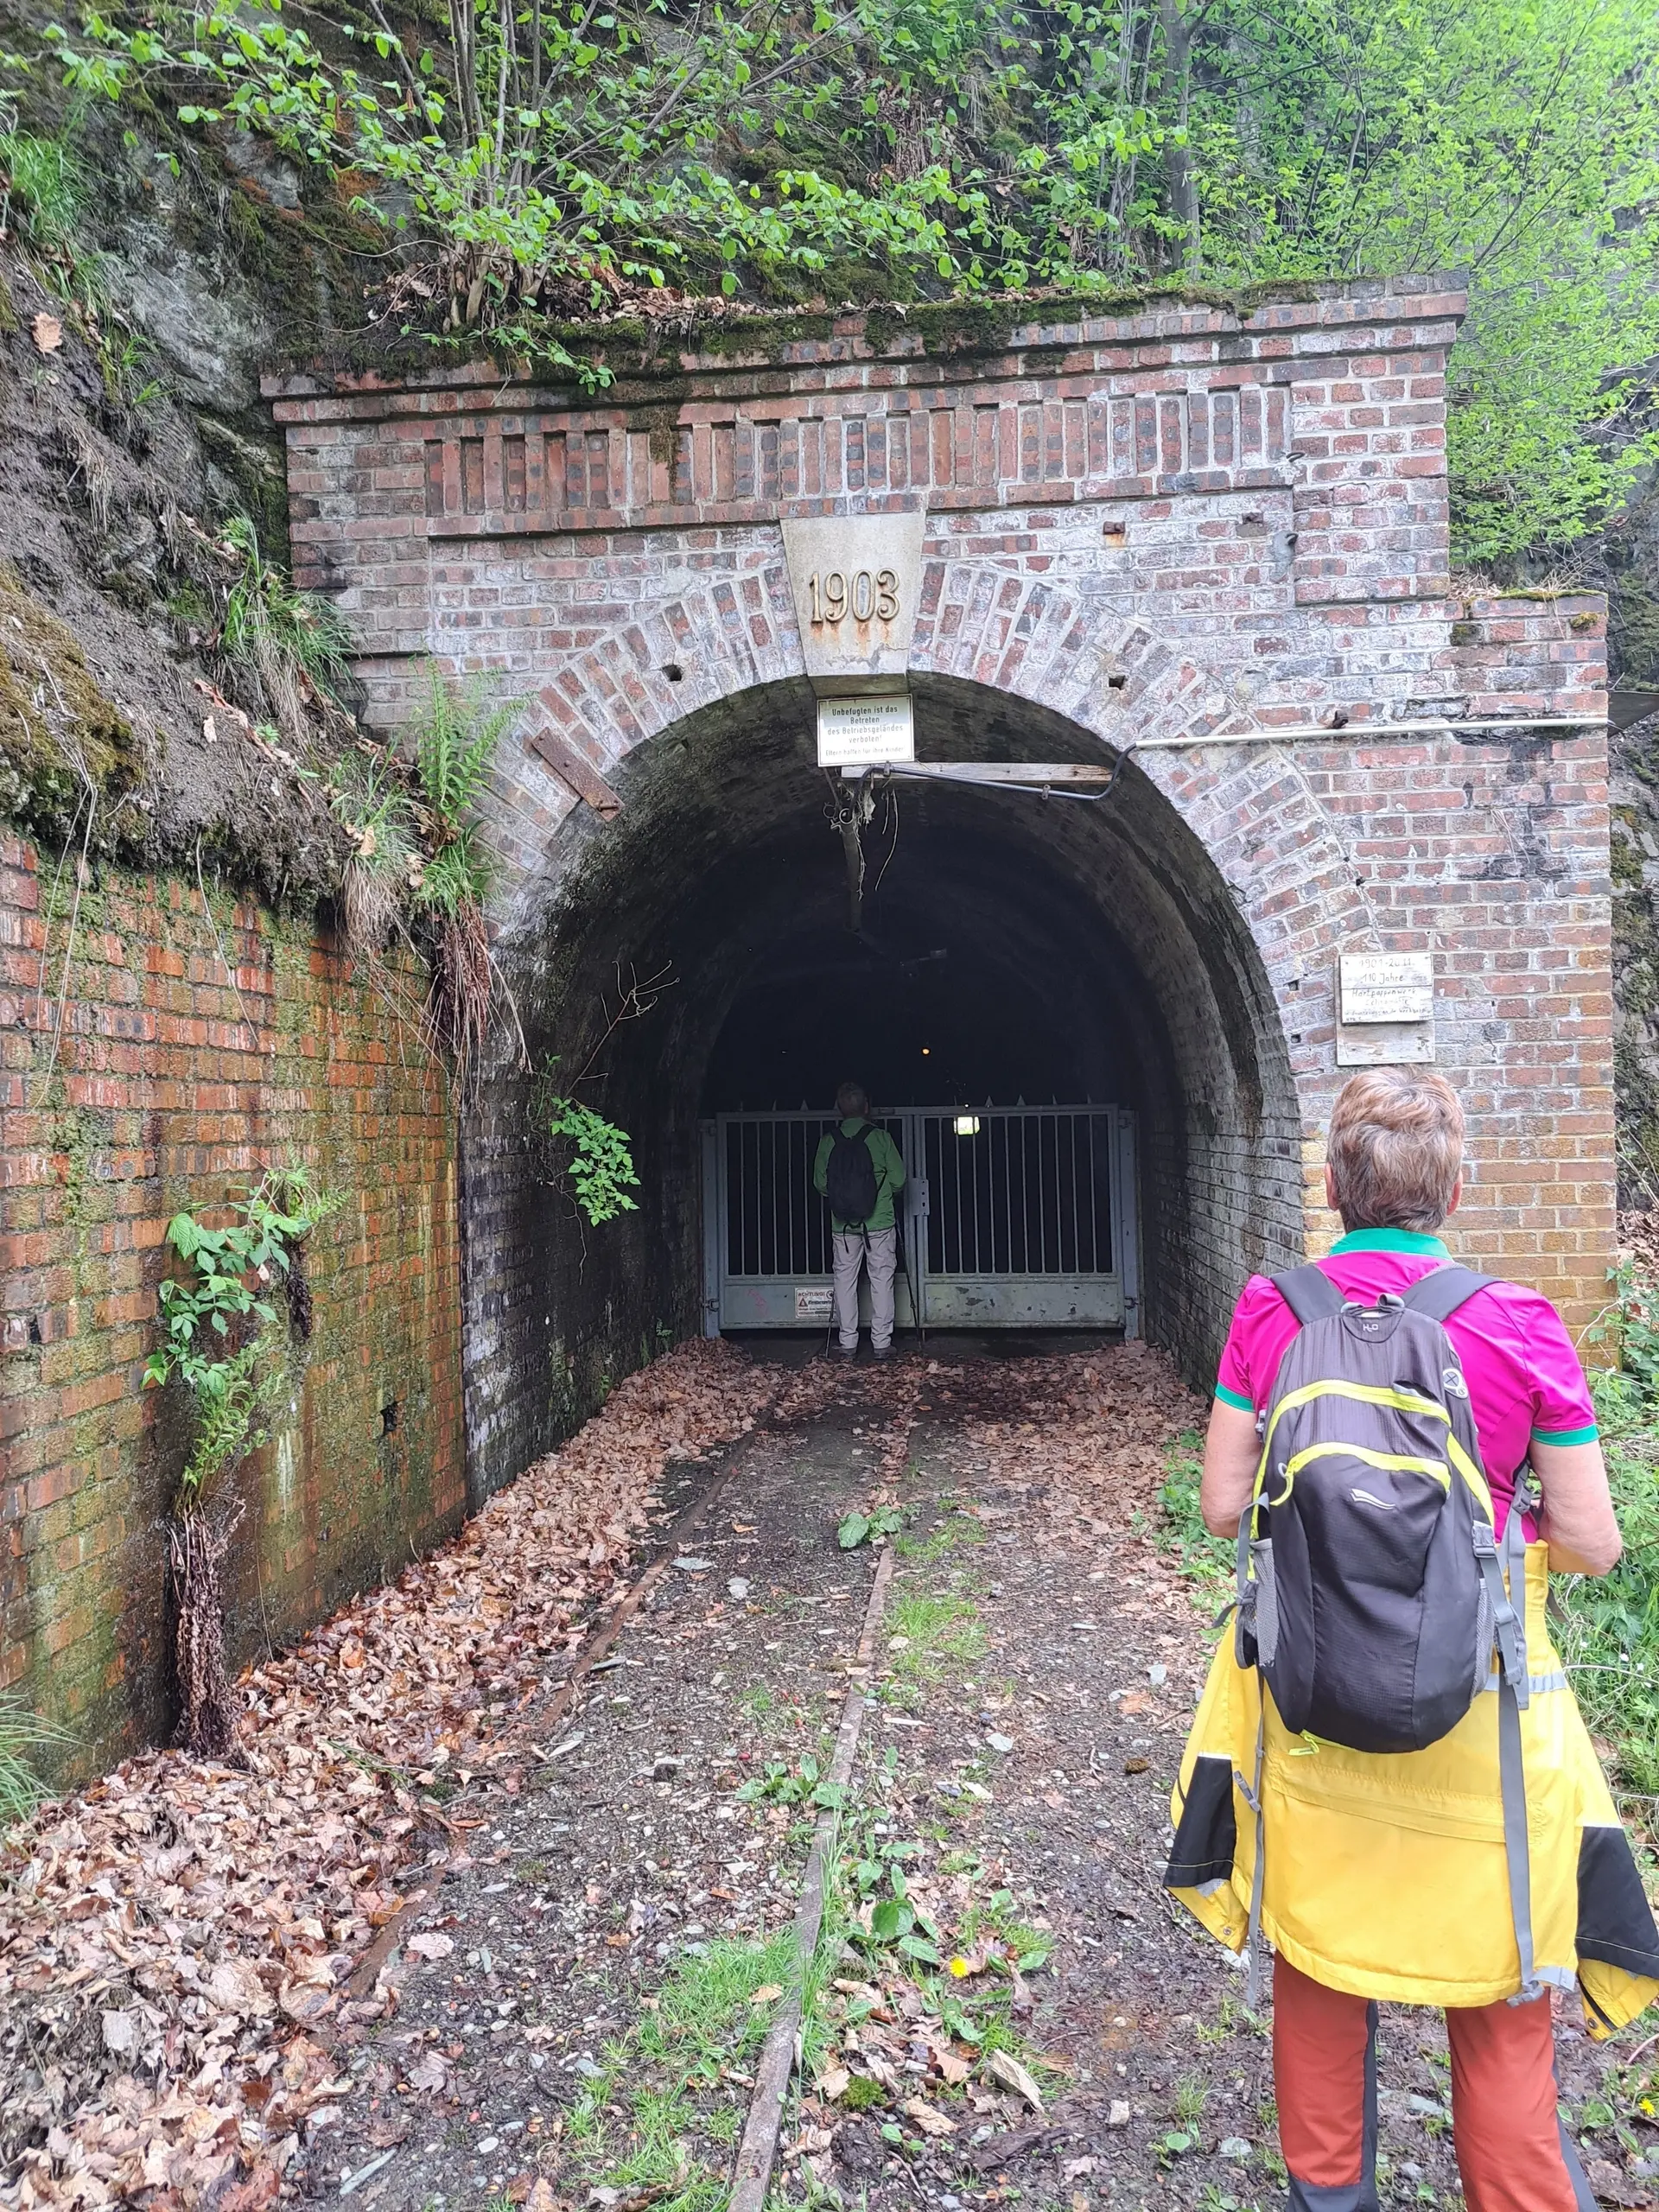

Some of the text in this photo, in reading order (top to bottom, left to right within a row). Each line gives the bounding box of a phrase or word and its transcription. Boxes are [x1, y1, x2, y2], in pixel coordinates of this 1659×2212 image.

[809, 567, 900, 623] 1903
[832, 707, 872, 716] Unbefugten
[842, 724, 903, 734] Betriebsgeländes
[1378, 971, 1405, 985] Jahre
